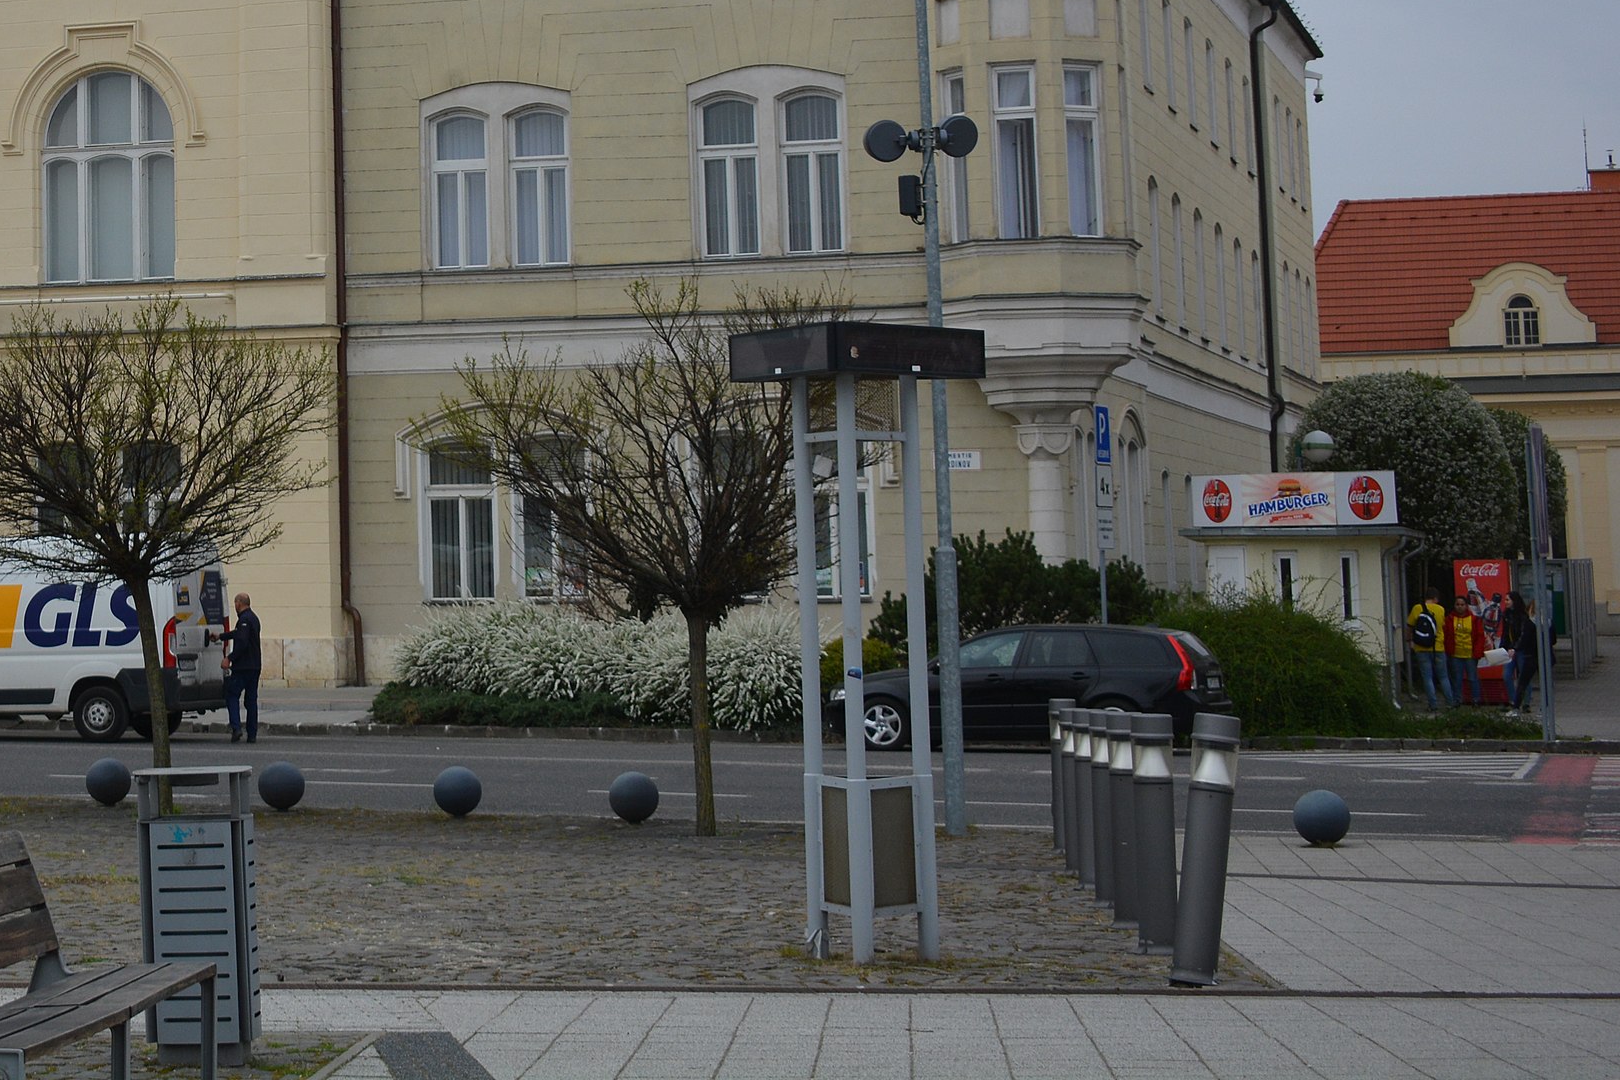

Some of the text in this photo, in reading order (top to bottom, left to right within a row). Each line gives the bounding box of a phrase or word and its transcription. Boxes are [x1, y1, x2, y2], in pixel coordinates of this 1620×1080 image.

[1098, 412, 1106, 444] P
[1248, 491, 1329, 517] HAMBURGER
[24, 583, 142, 648] GLS
